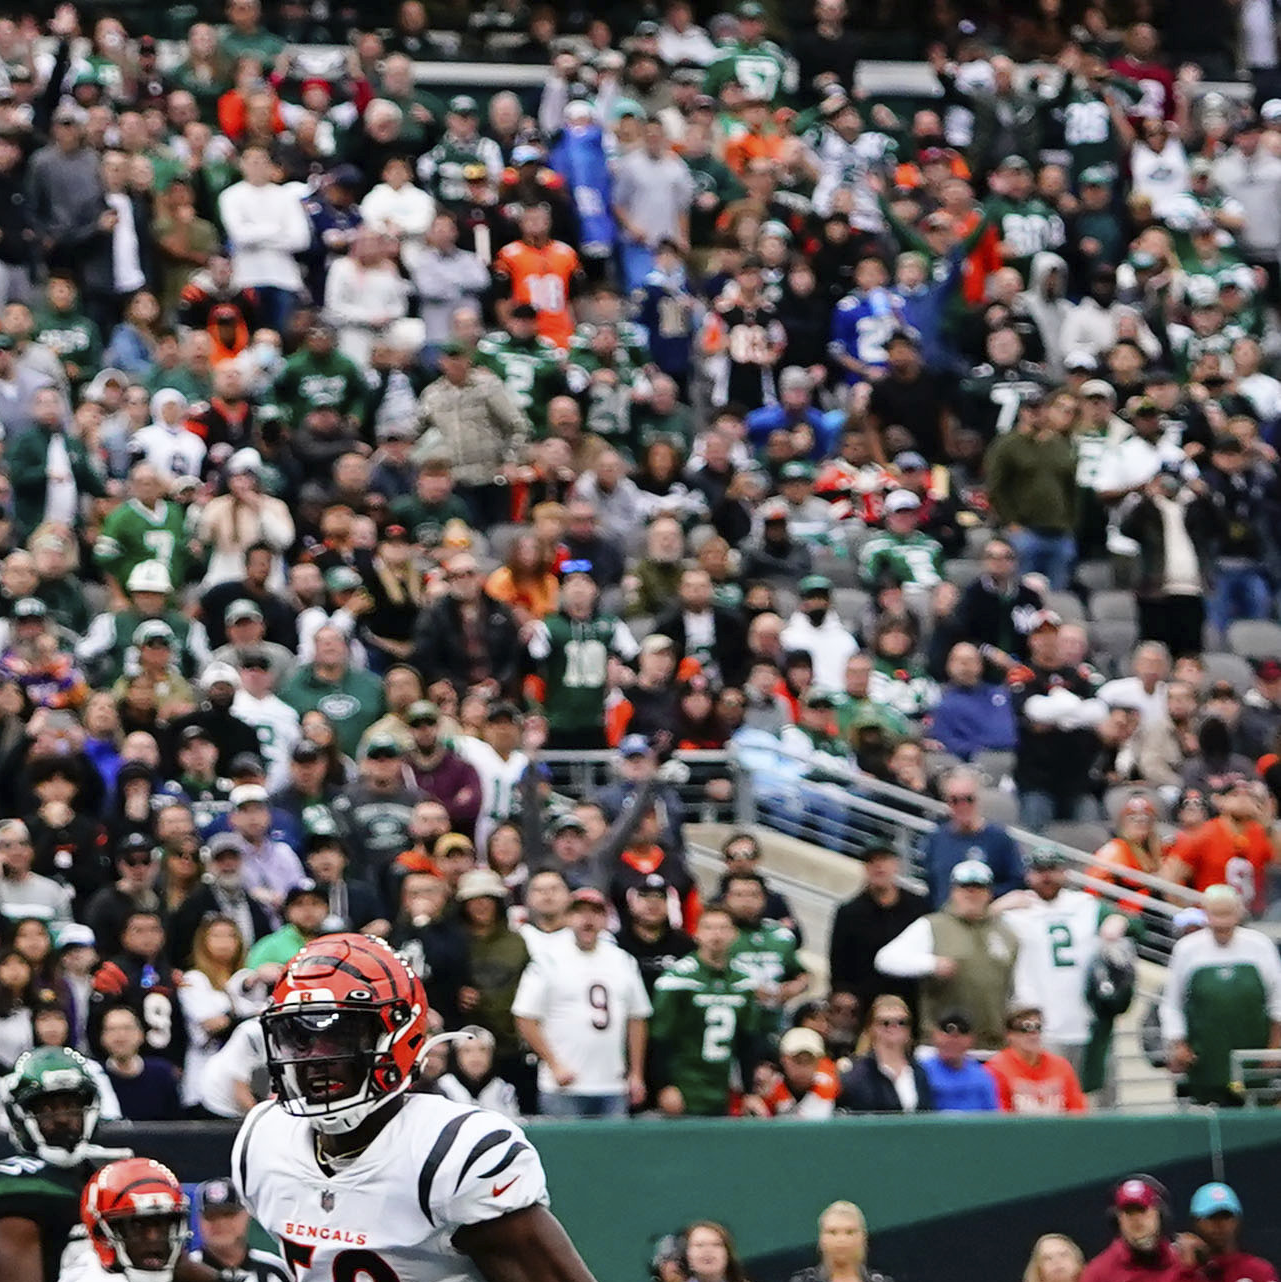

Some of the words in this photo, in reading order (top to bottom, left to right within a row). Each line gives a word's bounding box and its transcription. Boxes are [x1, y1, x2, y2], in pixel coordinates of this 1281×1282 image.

[1048, 924, 1075, 969] 2
[142, 991, 174, 1049] 9
[588, 984, 611, 1032] 9
[701, 1004, 735, 1063] 2
[285, 1222, 367, 1246] BENGALS
